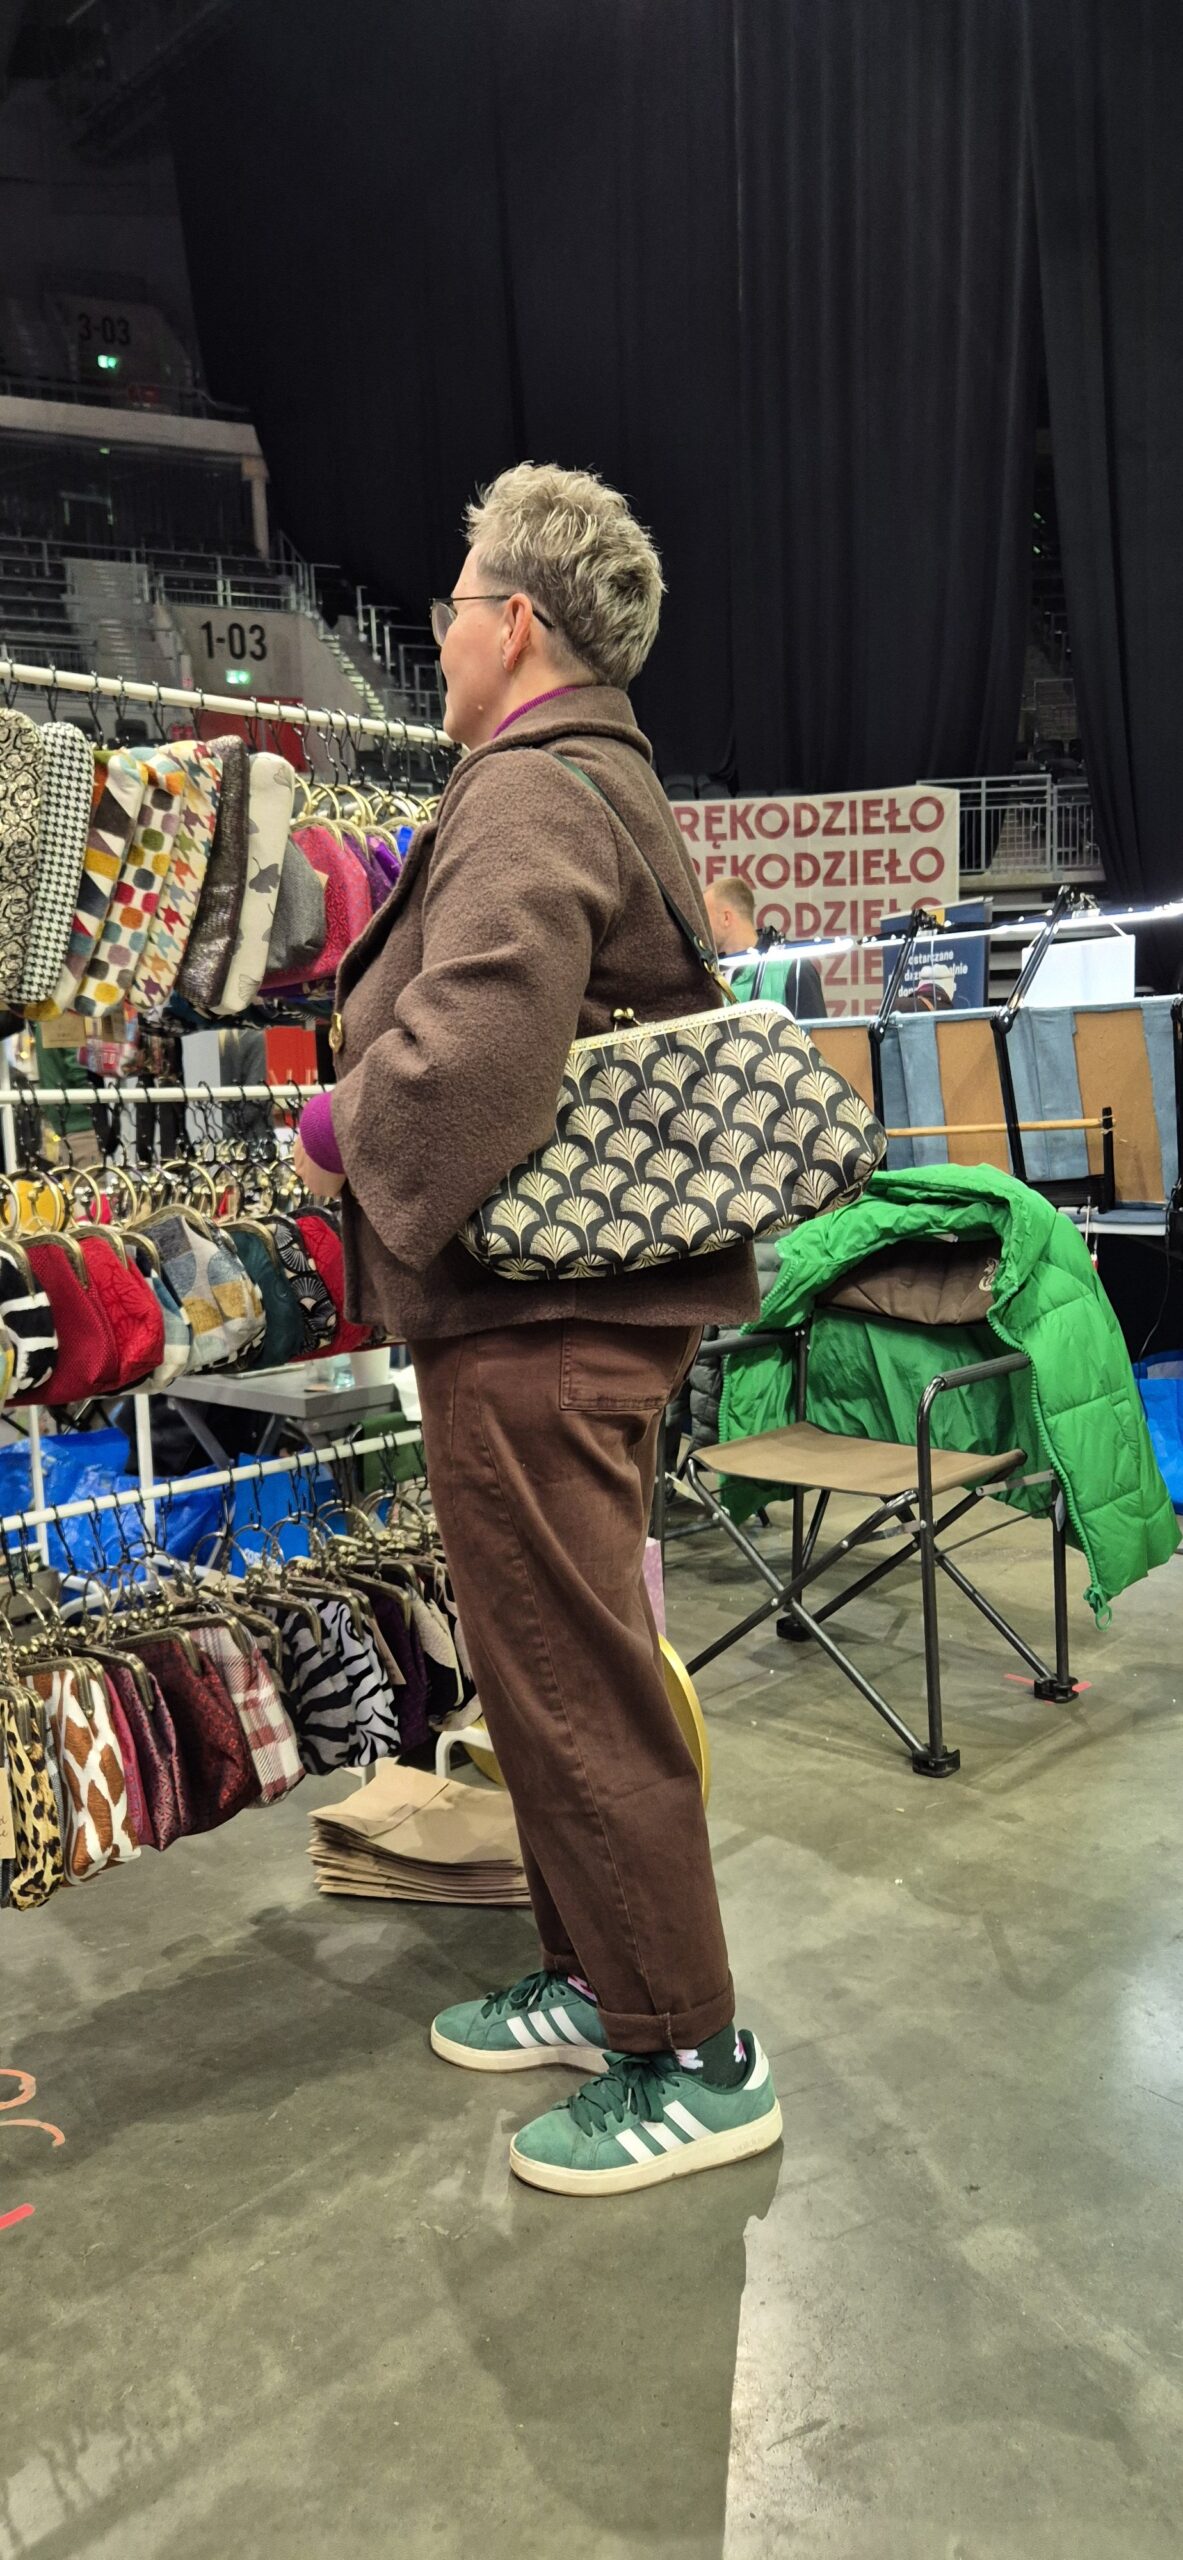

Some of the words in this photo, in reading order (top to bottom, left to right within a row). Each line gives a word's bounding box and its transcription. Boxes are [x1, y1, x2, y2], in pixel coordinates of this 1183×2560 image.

[78, 313, 130, 345] 3-03
[201, 620, 267, 661] 1-03
[673, 796, 945, 849] RĘKODZIEŁO
